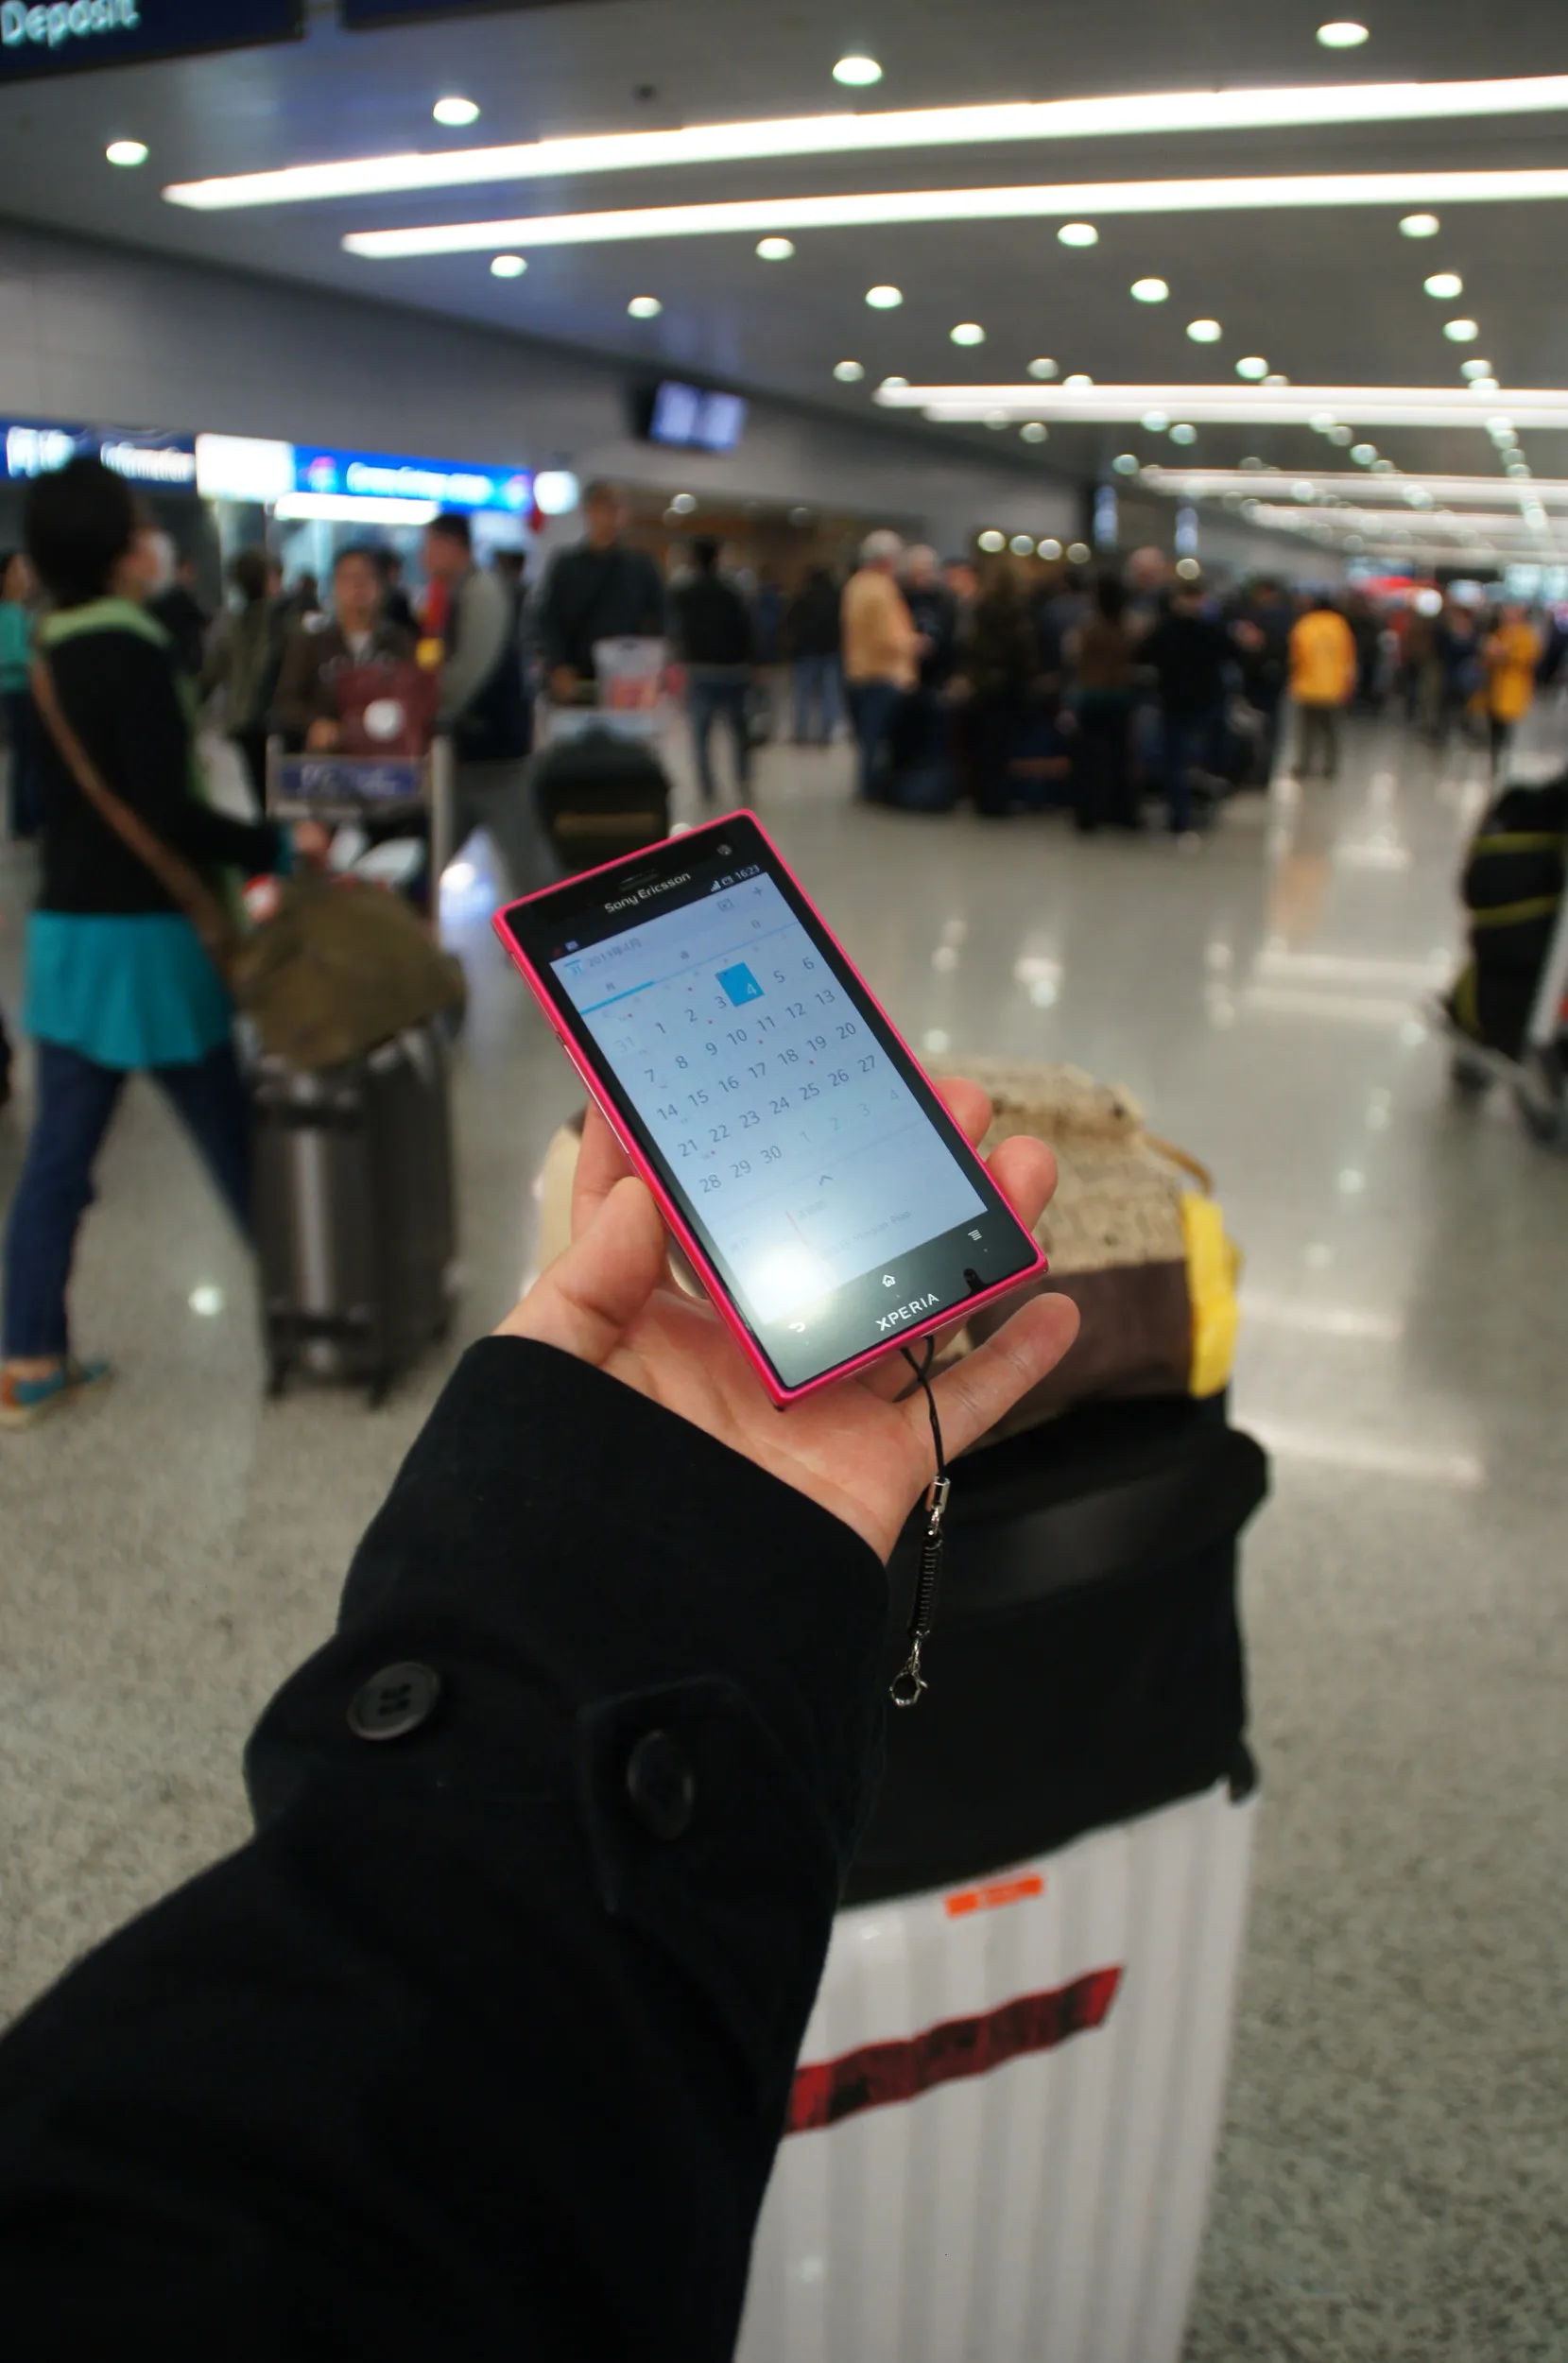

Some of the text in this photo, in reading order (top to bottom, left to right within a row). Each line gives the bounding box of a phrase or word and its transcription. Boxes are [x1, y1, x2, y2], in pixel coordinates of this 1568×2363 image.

[1, 0, 140, 49] Deposit
[604, 871, 692, 914] Sony Ericsson
[734, 864, 760, 880] 16:23
[655, 1022, 666, 1034] 1
[685, 1008, 698, 1023] 2
[715, 995, 727, 1009] 3
[746, 982, 757, 994] 4
[773, 969, 785, 983] 5
[802, 957, 815, 970] 6
[644, 990, 836, 1083] 7 8 9 10 11 12 13
[656, 1103, 679, 1121] 14
[687, 1089, 709, 1108] 15
[717, 1075, 740, 1093] 16
[748, 1061, 767, 1078] 17
[777, 1048, 800, 1065] 18
[806, 1035, 827, 1052] 19
[836, 1022, 857, 1040] 20
[678, 1054, 876, 1158] 21 22 23 24 25 26 27
[698, 1174, 722, 1193] 28
[729, 1160, 752, 1179] 29
[760, 1145, 783, 1164] 30
[875, 1292, 940, 1332] XPERIA
